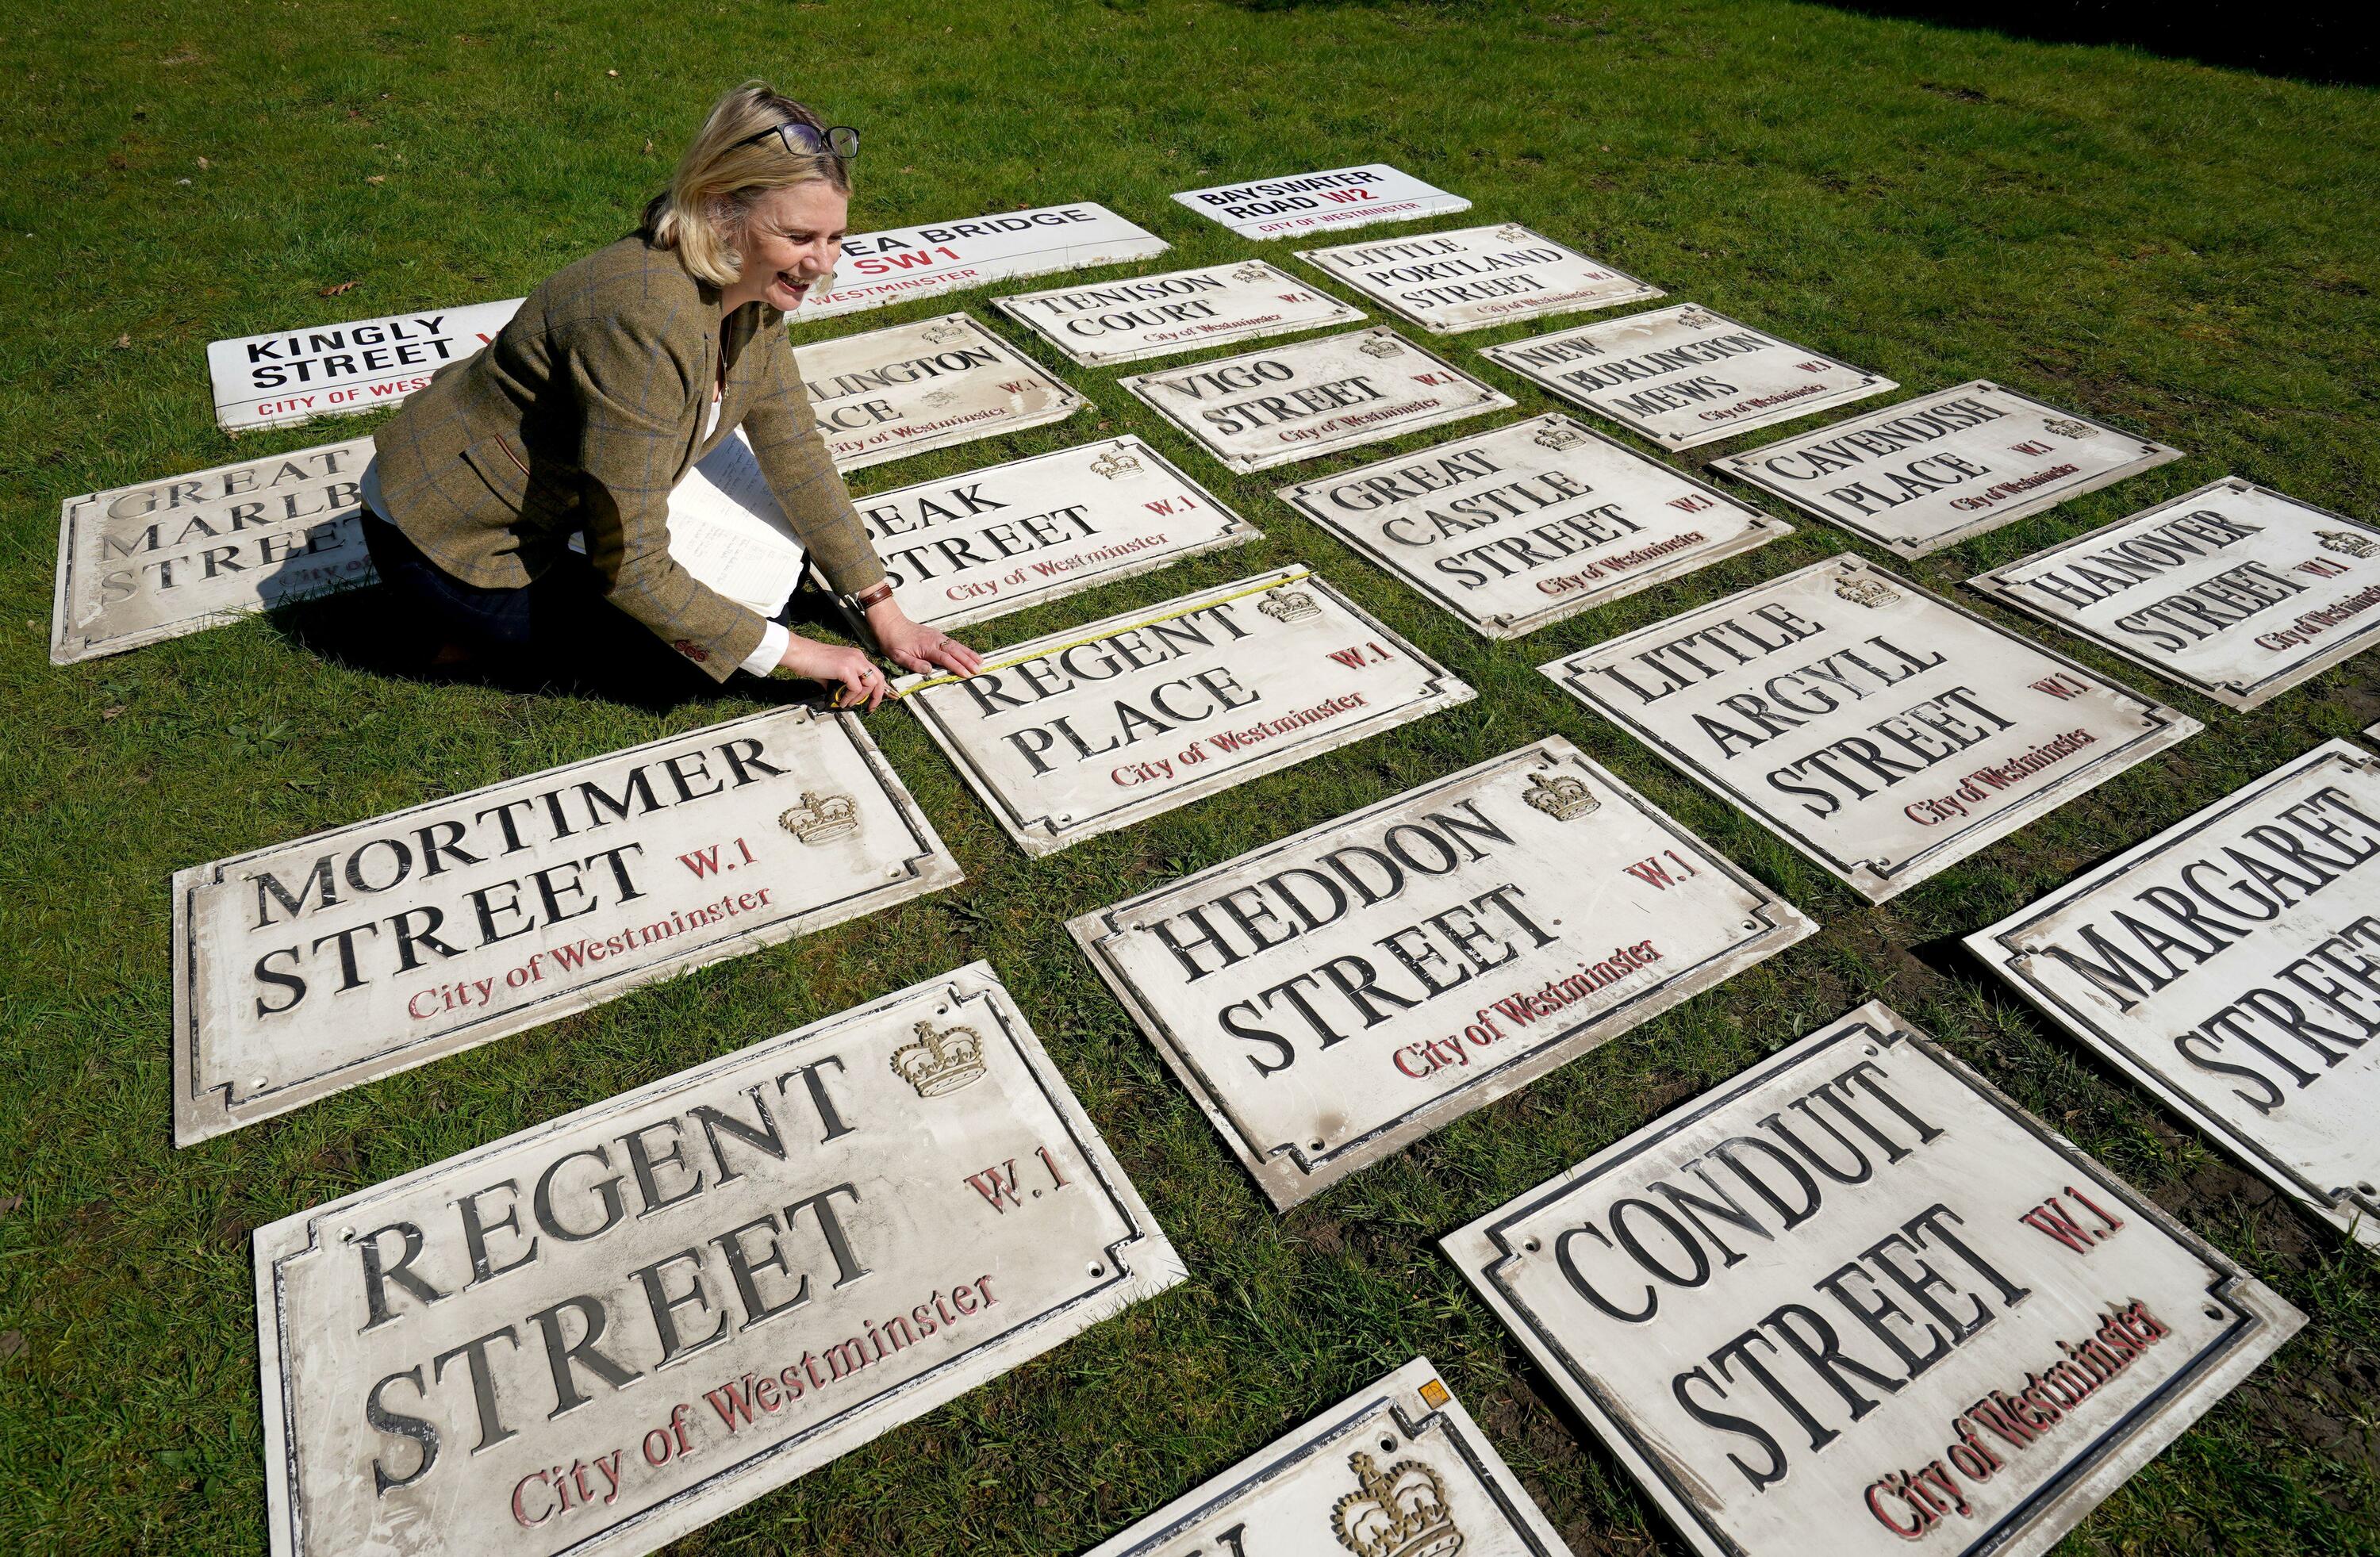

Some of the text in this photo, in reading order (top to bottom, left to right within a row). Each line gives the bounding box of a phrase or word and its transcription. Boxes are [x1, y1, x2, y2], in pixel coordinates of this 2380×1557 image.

[1196, 171, 1385, 206] BAYSWATER
[1224, 188, 1379, 220] ROAD W2
[1259, 201, 1421, 233] CITY OF WESTMINSTER
[918, 208, 1096, 244] BRIDGE
[1329, 238, 1468, 268] LITTLE
[808, 269, 979, 305] WESTMINSTER
[854, 246, 961, 274] SW1
[1363, 247, 1564, 287] PORTLAND
[1400, 271, 1615, 309] STREET W.1
[1027, 273, 1227, 316] TENISON
[1066, 291, 1317, 337] COURT W.1
[1477, 290, 1597, 314] City of Westminster
[247, 316, 445, 363] KINGLY
[1143, 313, 1283, 343] City of Westminster
[1509, 336, 1606, 370] NEW
[251, 337, 454, 389] STREET
[996, 378, 1041, 394] W.1
[1164, 360, 1295, 399] VIGO
[1558, 332, 1775, 393] BURLINGTON
[1609, 360, 1833, 419] MEWS W.1
[258, 395, 316, 416] CITY
[328, 388, 360, 404] OF
[869, 431, 889, 445] of
[892, 406, 1011, 439] Westminster
[1203, 370, 1463, 435] STREET W.1
[1279, 397, 1441, 442] City of Westminster
[1698, 385, 1827, 421] City of Westminster
[1765, 398, 2010, 480] CAVENDISH
[106, 449, 350, 520] GREAT
[1142, 495, 1199, 517] W.1
[1330, 448, 1507, 511] GREAT
[1382, 470, 1595, 547] CASTLE
[1823, 440, 2057, 516] PLACE W.1
[1949, 463, 2082, 512] City of Westminster
[865, 482, 1011, 541] EAK
[1435, 493, 1719, 590] STREET W.1
[101, 516, 362, 609] STREE
[946, 531, 1171, 601] City of Westminster
[1536, 530, 1706, 596] City of Westminster
[2021, 509, 2266, 611] HANOVER
[2114, 556, 2353, 653] STREET W.1
[2253, 630, 2312, 652] City
[2293, 618, 2325, 635] of
[952, 603, 1253, 720] REGENT
[1598, 603, 1826, 706] LITTLE
[1001, 641, 1397, 779] PLACE W.1
[1691, 635, 1948, 760] ARGYLL
[1111, 689, 1371, 788] City of Westminster
[1767, 673, 2094, 820] STREET W.1
[1904, 727, 2098, 826] City of Westminster
[247, 738, 791, 932] MORTIMER
[1142, 800, 1517, 985] HEDDON
[2040, 786, 2380, 1014] MARGARET
[253, 837, 760, 1022] STREET W.1
[407, 885, 773, 1021] City of Westminster
[1219, 849, 1701, 1080] STREET W.1
[1392, 937, 1661, 1080] City of Westminster
[349, 1054, 858, 1335] REGENT
[1555, 1060, 1946, 1326] CONDUIT
[366, 1146, 1072, 1499] STREET W.1
[1672, 1186, 2124, 1494] STREET W.1
[510, 1273, 1001, 1529] City of Westminster
[1864, 1298, 2171, 1540] City of Westminster
